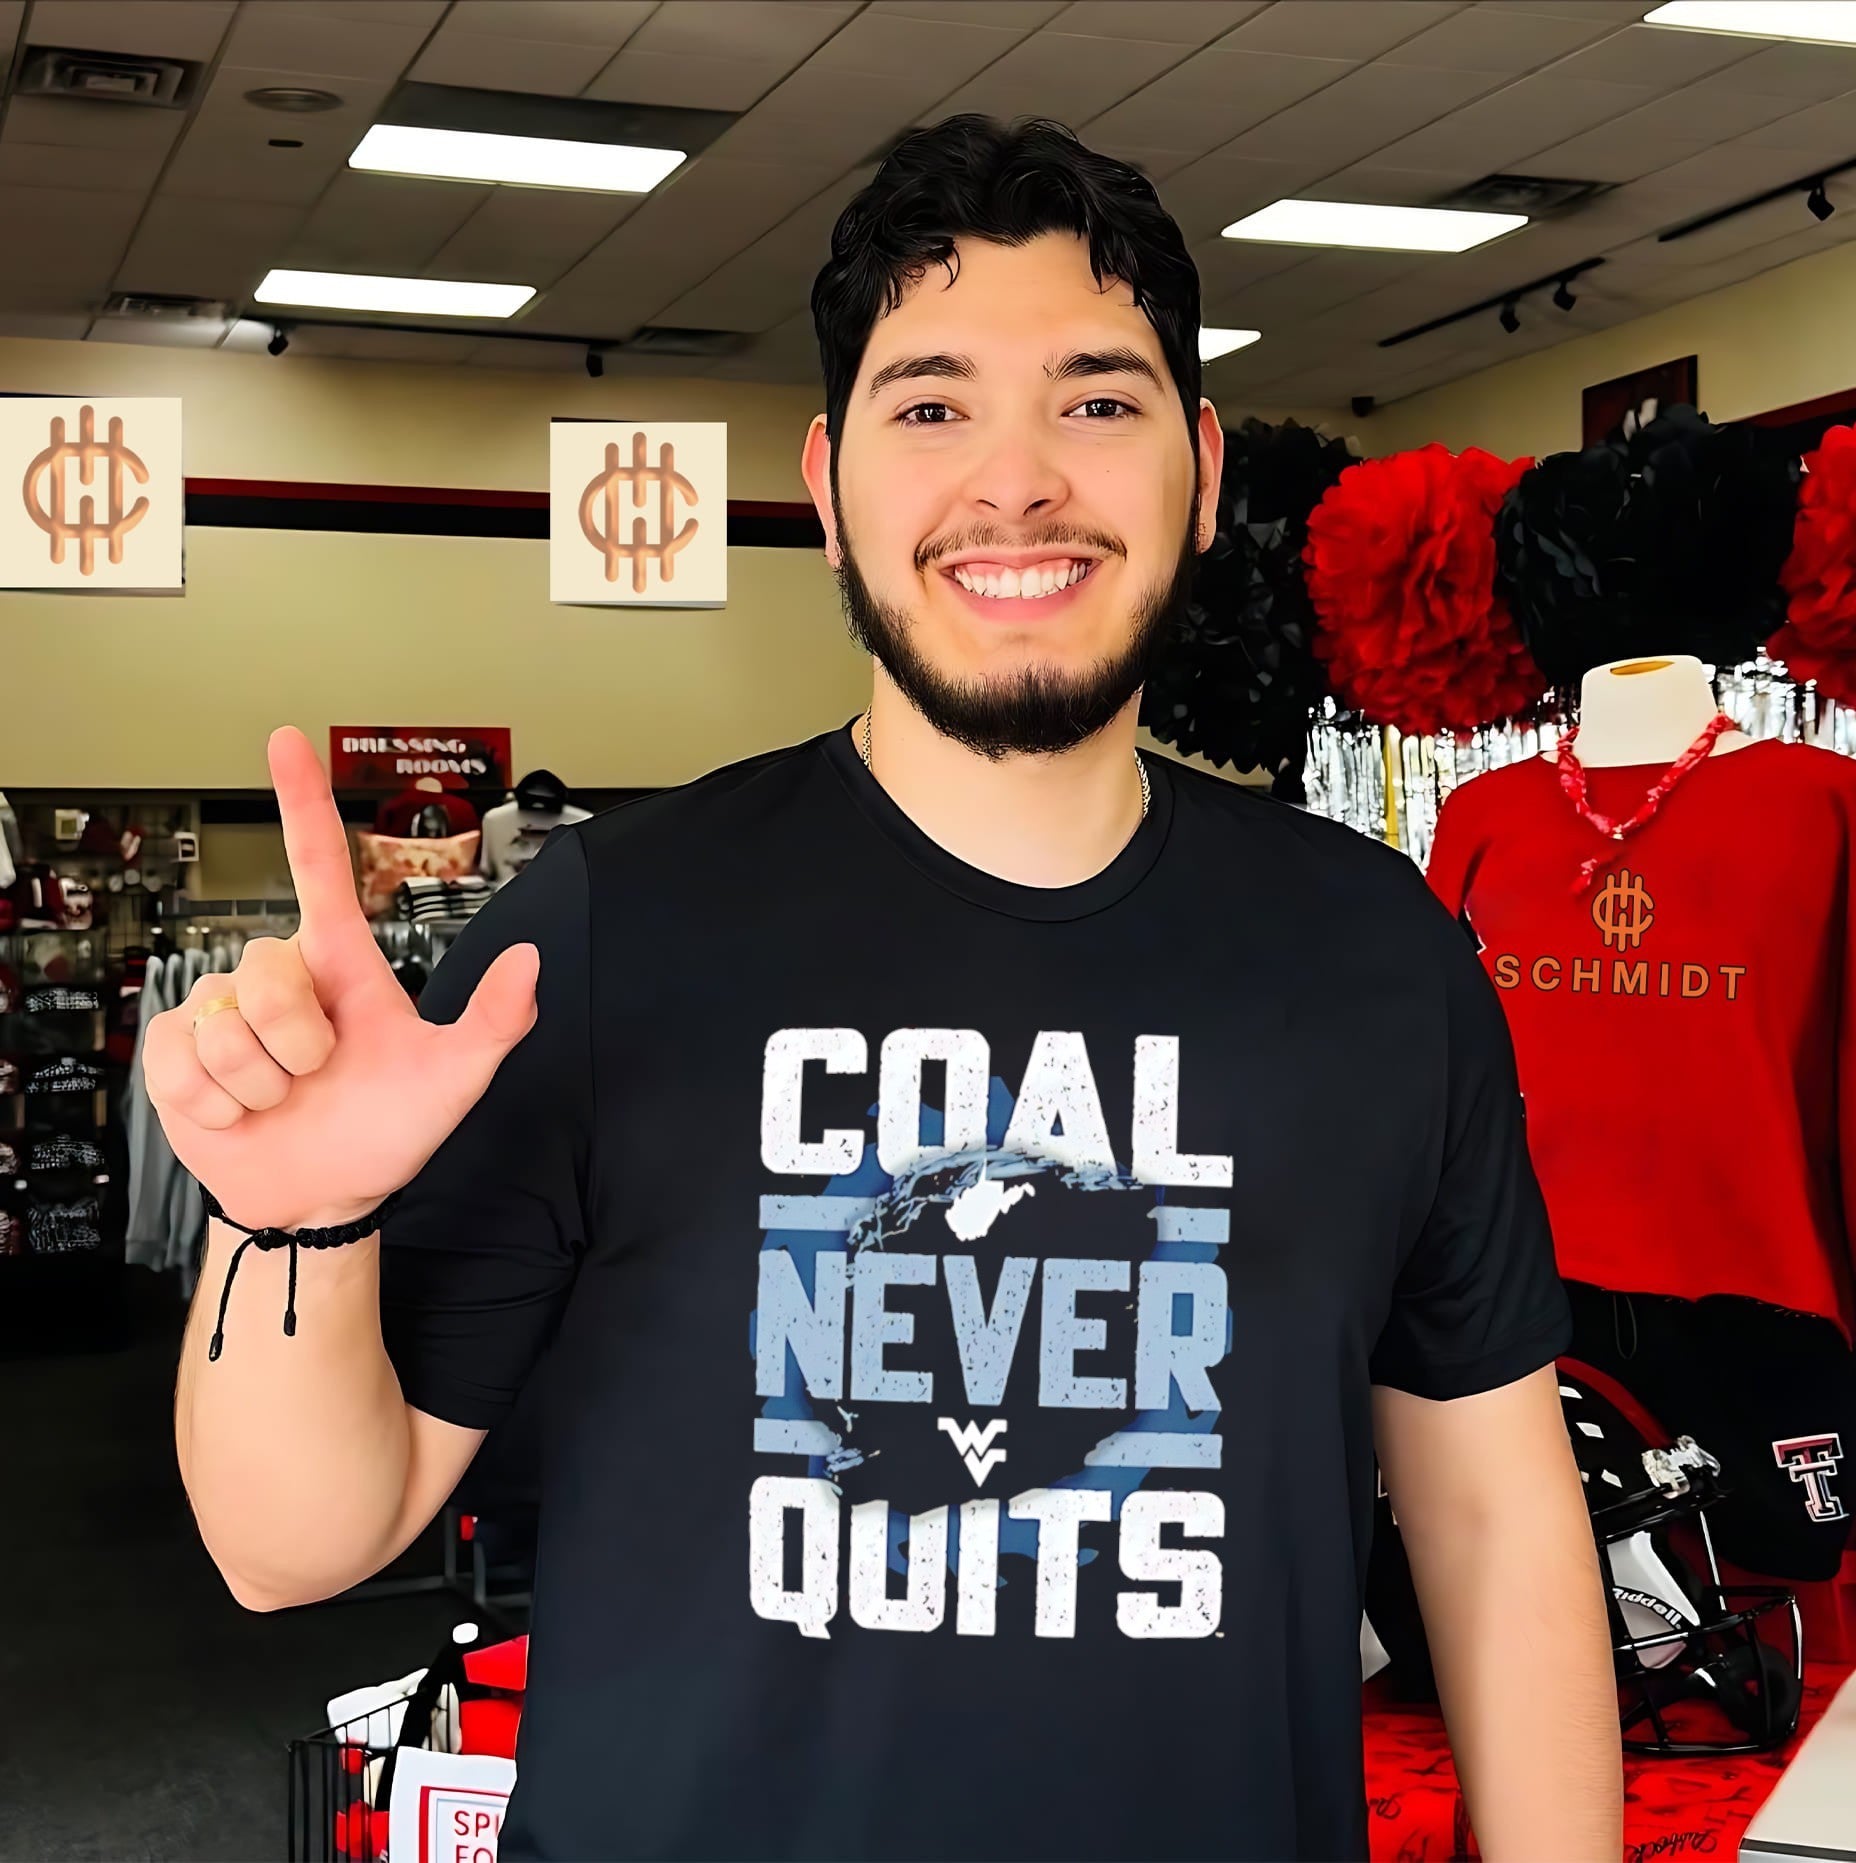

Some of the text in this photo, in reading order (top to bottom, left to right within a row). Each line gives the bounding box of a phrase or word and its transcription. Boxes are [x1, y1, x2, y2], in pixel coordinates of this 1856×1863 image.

[1494, 954, 1747, 1000] SCHMIDT
[760, 1028, 1234, 1188] COAL
[756, 1249, 1229, 1412] NEVER
[749, 1475, 1226, 1640] QUITS
